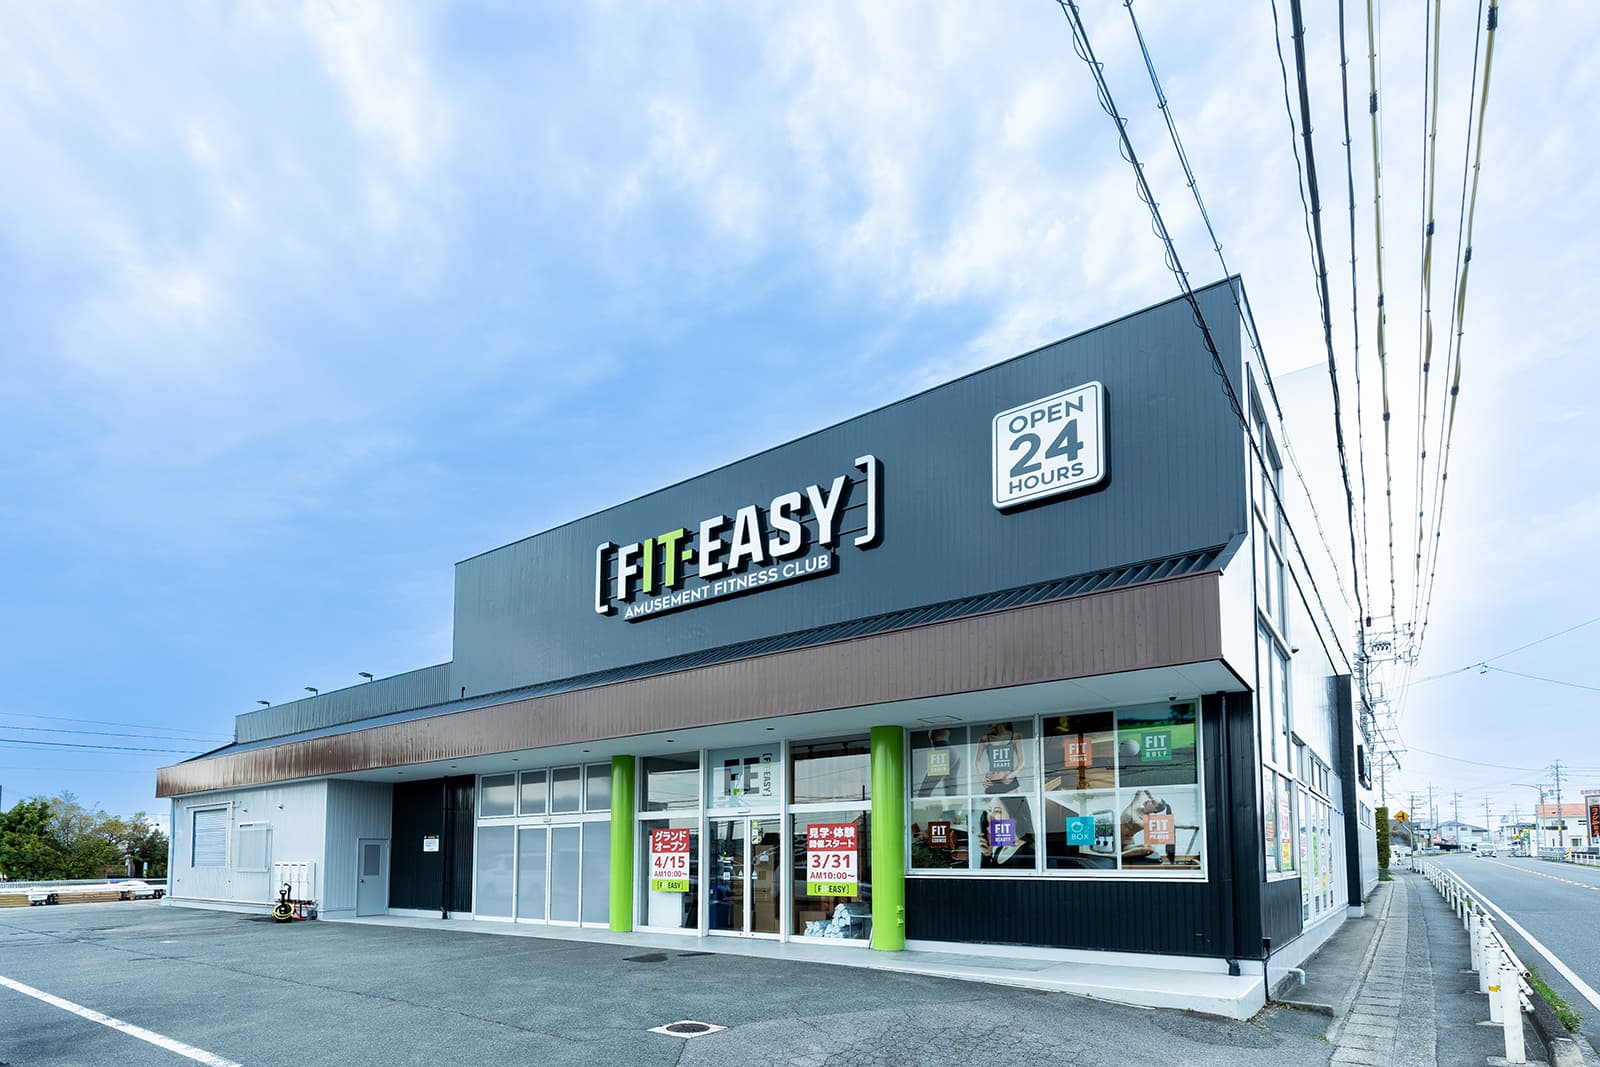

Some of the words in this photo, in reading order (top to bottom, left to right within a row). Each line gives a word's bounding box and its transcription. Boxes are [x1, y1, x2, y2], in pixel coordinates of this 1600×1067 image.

[1008, 395, 1084, 434] OPEN
[1009, 418, 1084, 478] 24
[1009, 462, 1084, 494] HOURS
[624, 585, 711, 620] AMUSEMENT
[714, 567, 778, 594] FITNESS
[782, 554, 829, 578] CLUB
[1145, 735, 1167, 748] FIT
[992, 748, 1011, 759] FIT
[1069, 742, 1088, 754] FIT
[930, 753, 946, 764] FIT
[931, 825, 947, 836] FIT
[994, 823, 1011, 834] FIT
[1149, 819, 1169, 831] FIT
[655, 830, 687, 842] グランド
[655, 841, 687, 851] オープン
[654, 855, 686, 869] 4/15
[811, 854, 850, 869] 3/31
